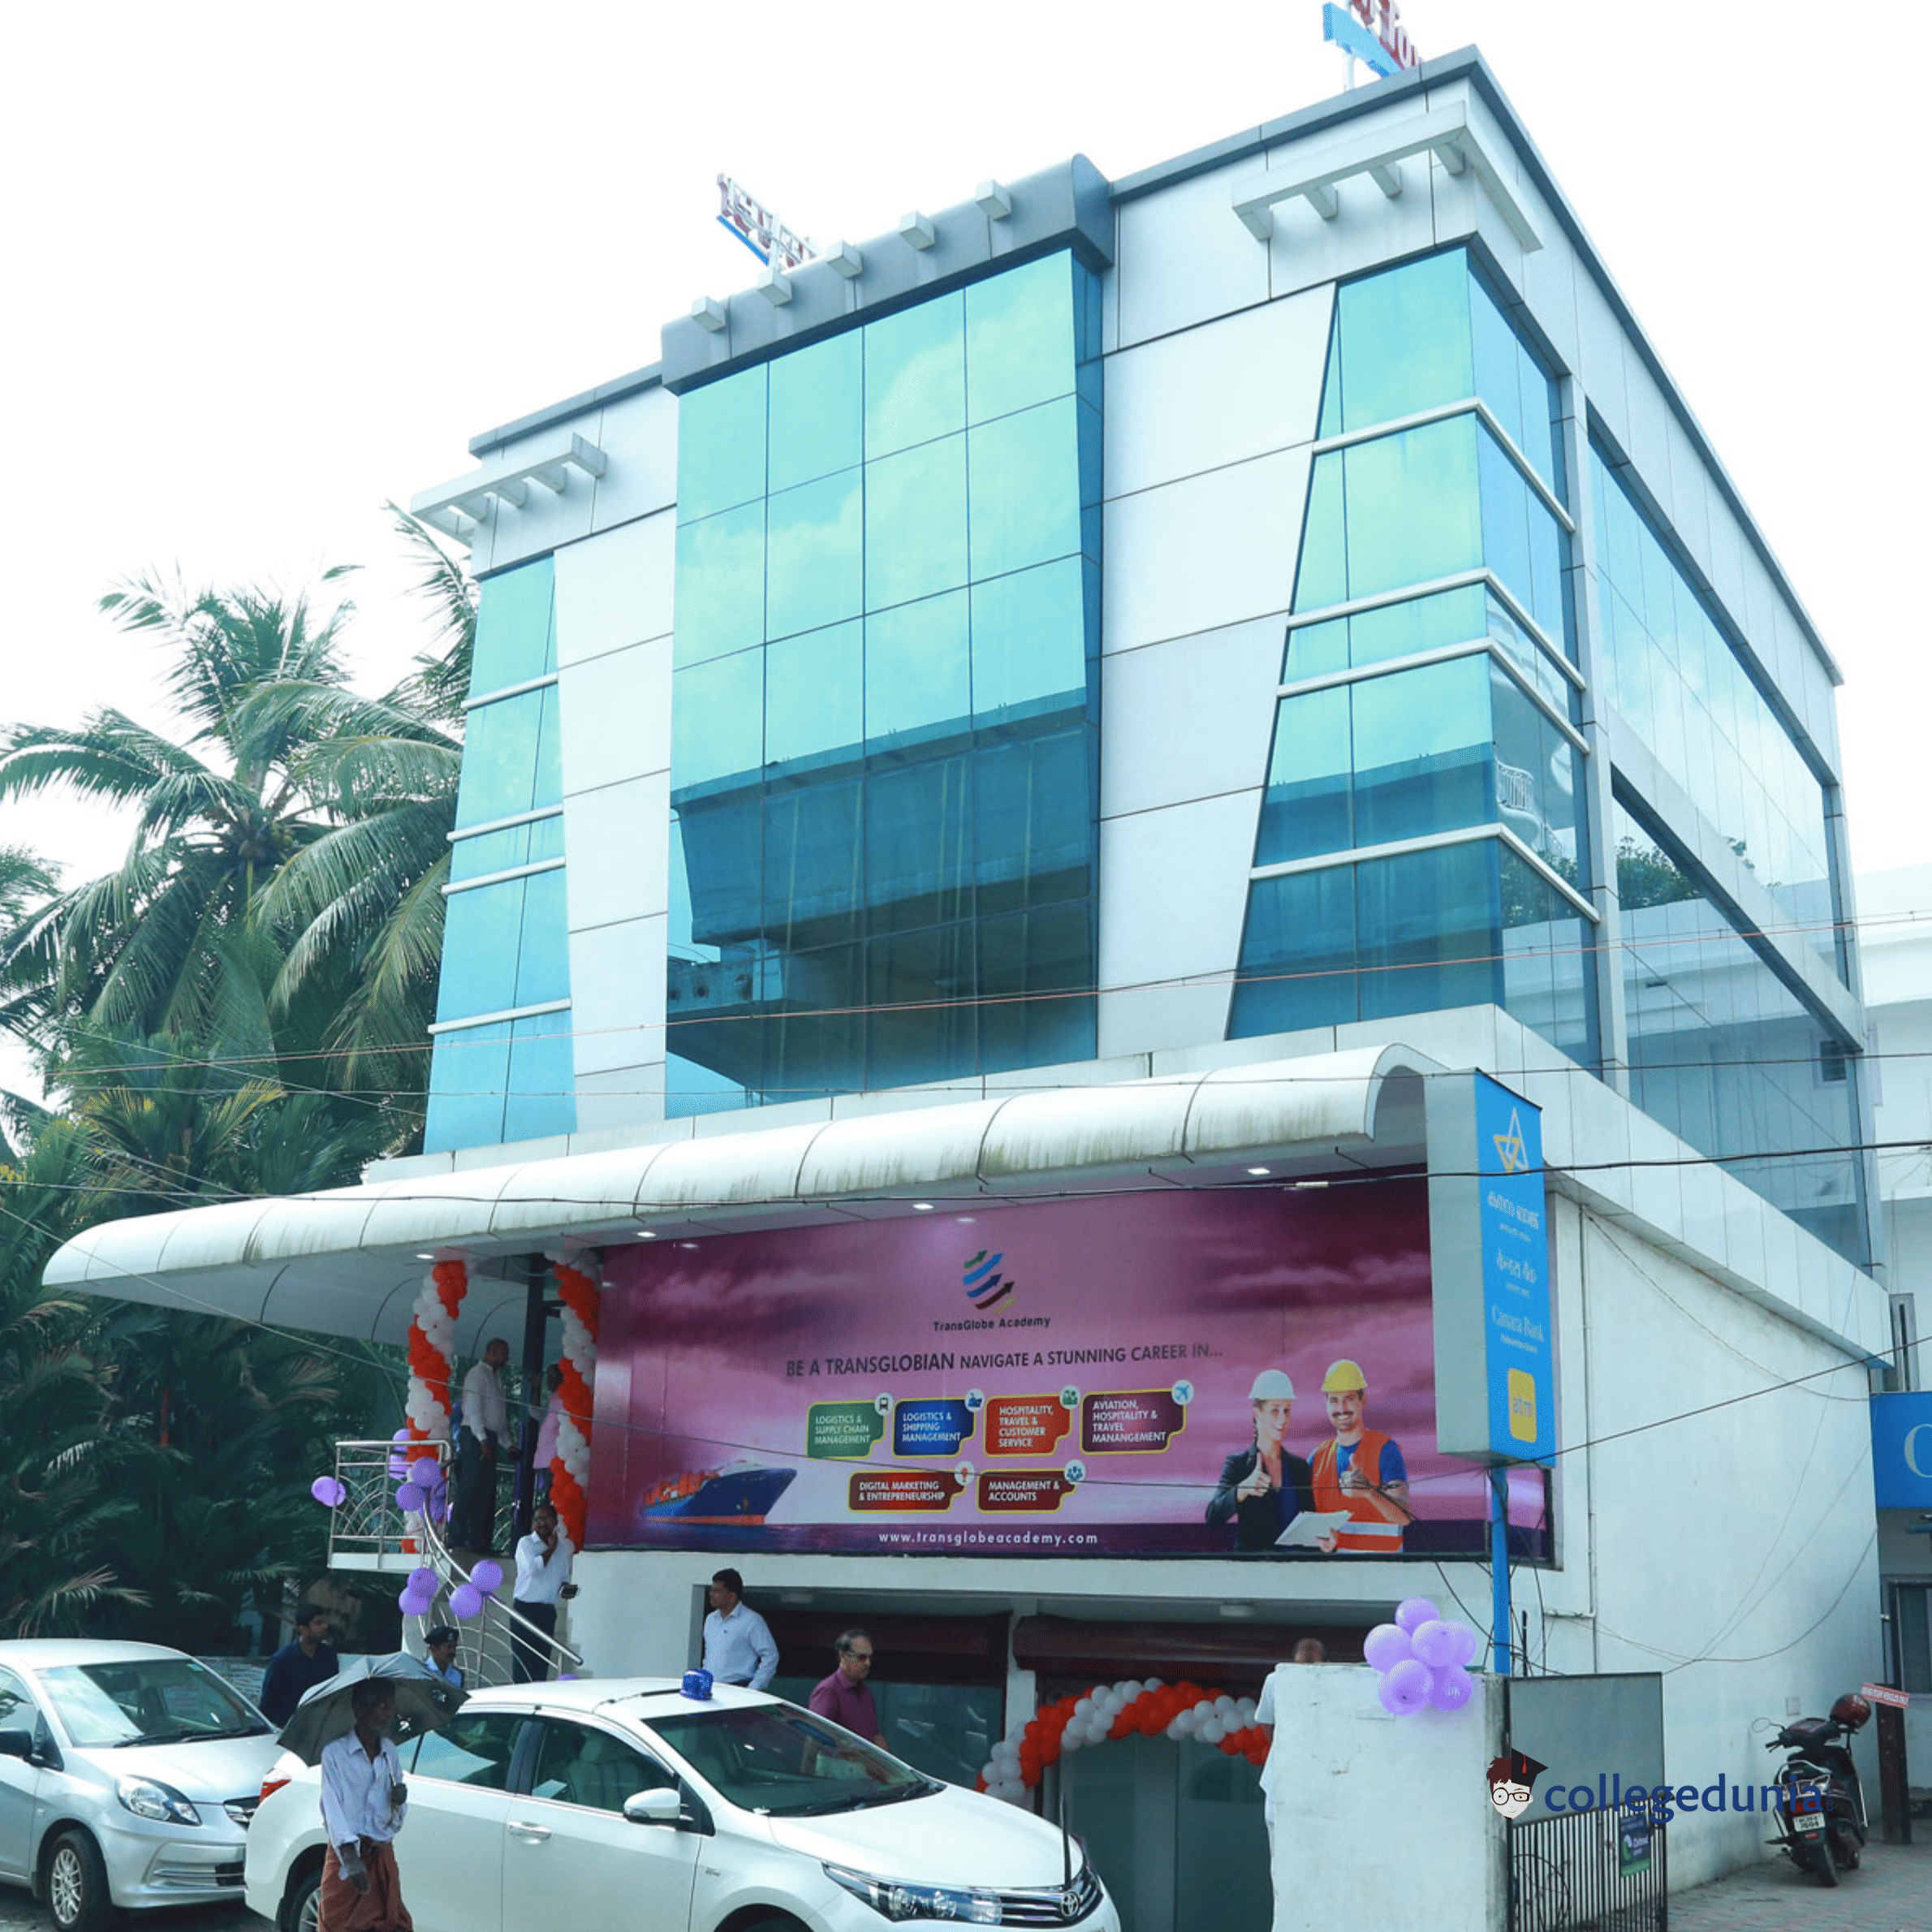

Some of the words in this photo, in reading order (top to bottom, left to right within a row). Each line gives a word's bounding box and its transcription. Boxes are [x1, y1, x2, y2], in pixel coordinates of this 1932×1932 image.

[934, 1319, 994, 1332] TransGlobe
[999, 1317, 1051, 1329] Academy
[786, 1359, 804, 1378] BE
[809, 1359, 821, 1376] A
[826, 1352, 955, 1376] TRANSGLOBIAN
[960, 1352, 1029, 1369] NAVIGATE
[1033, 1352, 1044, 1366] A
[1047, 1347, 1127, 1365] STUNNING
[1131, 1343, 1188, 1362] CAREER
[1092, 1400, 1139, 1411] AVIATION,
[815, 1415, 854, 1425] LOGISTICS
[856, 1415, 862, 1423] &
[902, 1412, 944, 1421] LOGISTICS
[946, 1412, 952, 1421] &
[1092, 1410, 1149, 1421] HOSPITALITY
[1150, 1410, 1158, 1419] &
[999, 1417, 1029, 1425] TRAVEL
[1032, 1417, 1038, 1425] &
[815, 1425, 841, 1434] SUPPLY
[843, 1424, 869, 1434] CHAIN
[902, 1421, 941, 1432] SHIPPING
[1092, 1423, 1125, 1432] TRAVEL
[998, 1427, 1046, 1437] CUSTOMER
[814, 1434, 871, 1444] MANAGEMENT
[902, 1433, 961, 1443] MANAGEMENT
[998, 1438, 1033, 1447] SERVICE
[859, 1481, 891, 1491] DIGITAL
[892, 1481, 939, 1490] MARKETING
[988, 1481, 1051, 1490] MANAGEMENT
[1053, 1481, 1060, 1490] &
[859, 1492, 865, 1502] &
[867, 1491, 946, 1502] ENTREPRENEURSHIP
[988, 1491, 1037, 1502] ACCOUNTS
[878, 1529, 1098, 1547] www.transglobeacademy.com
